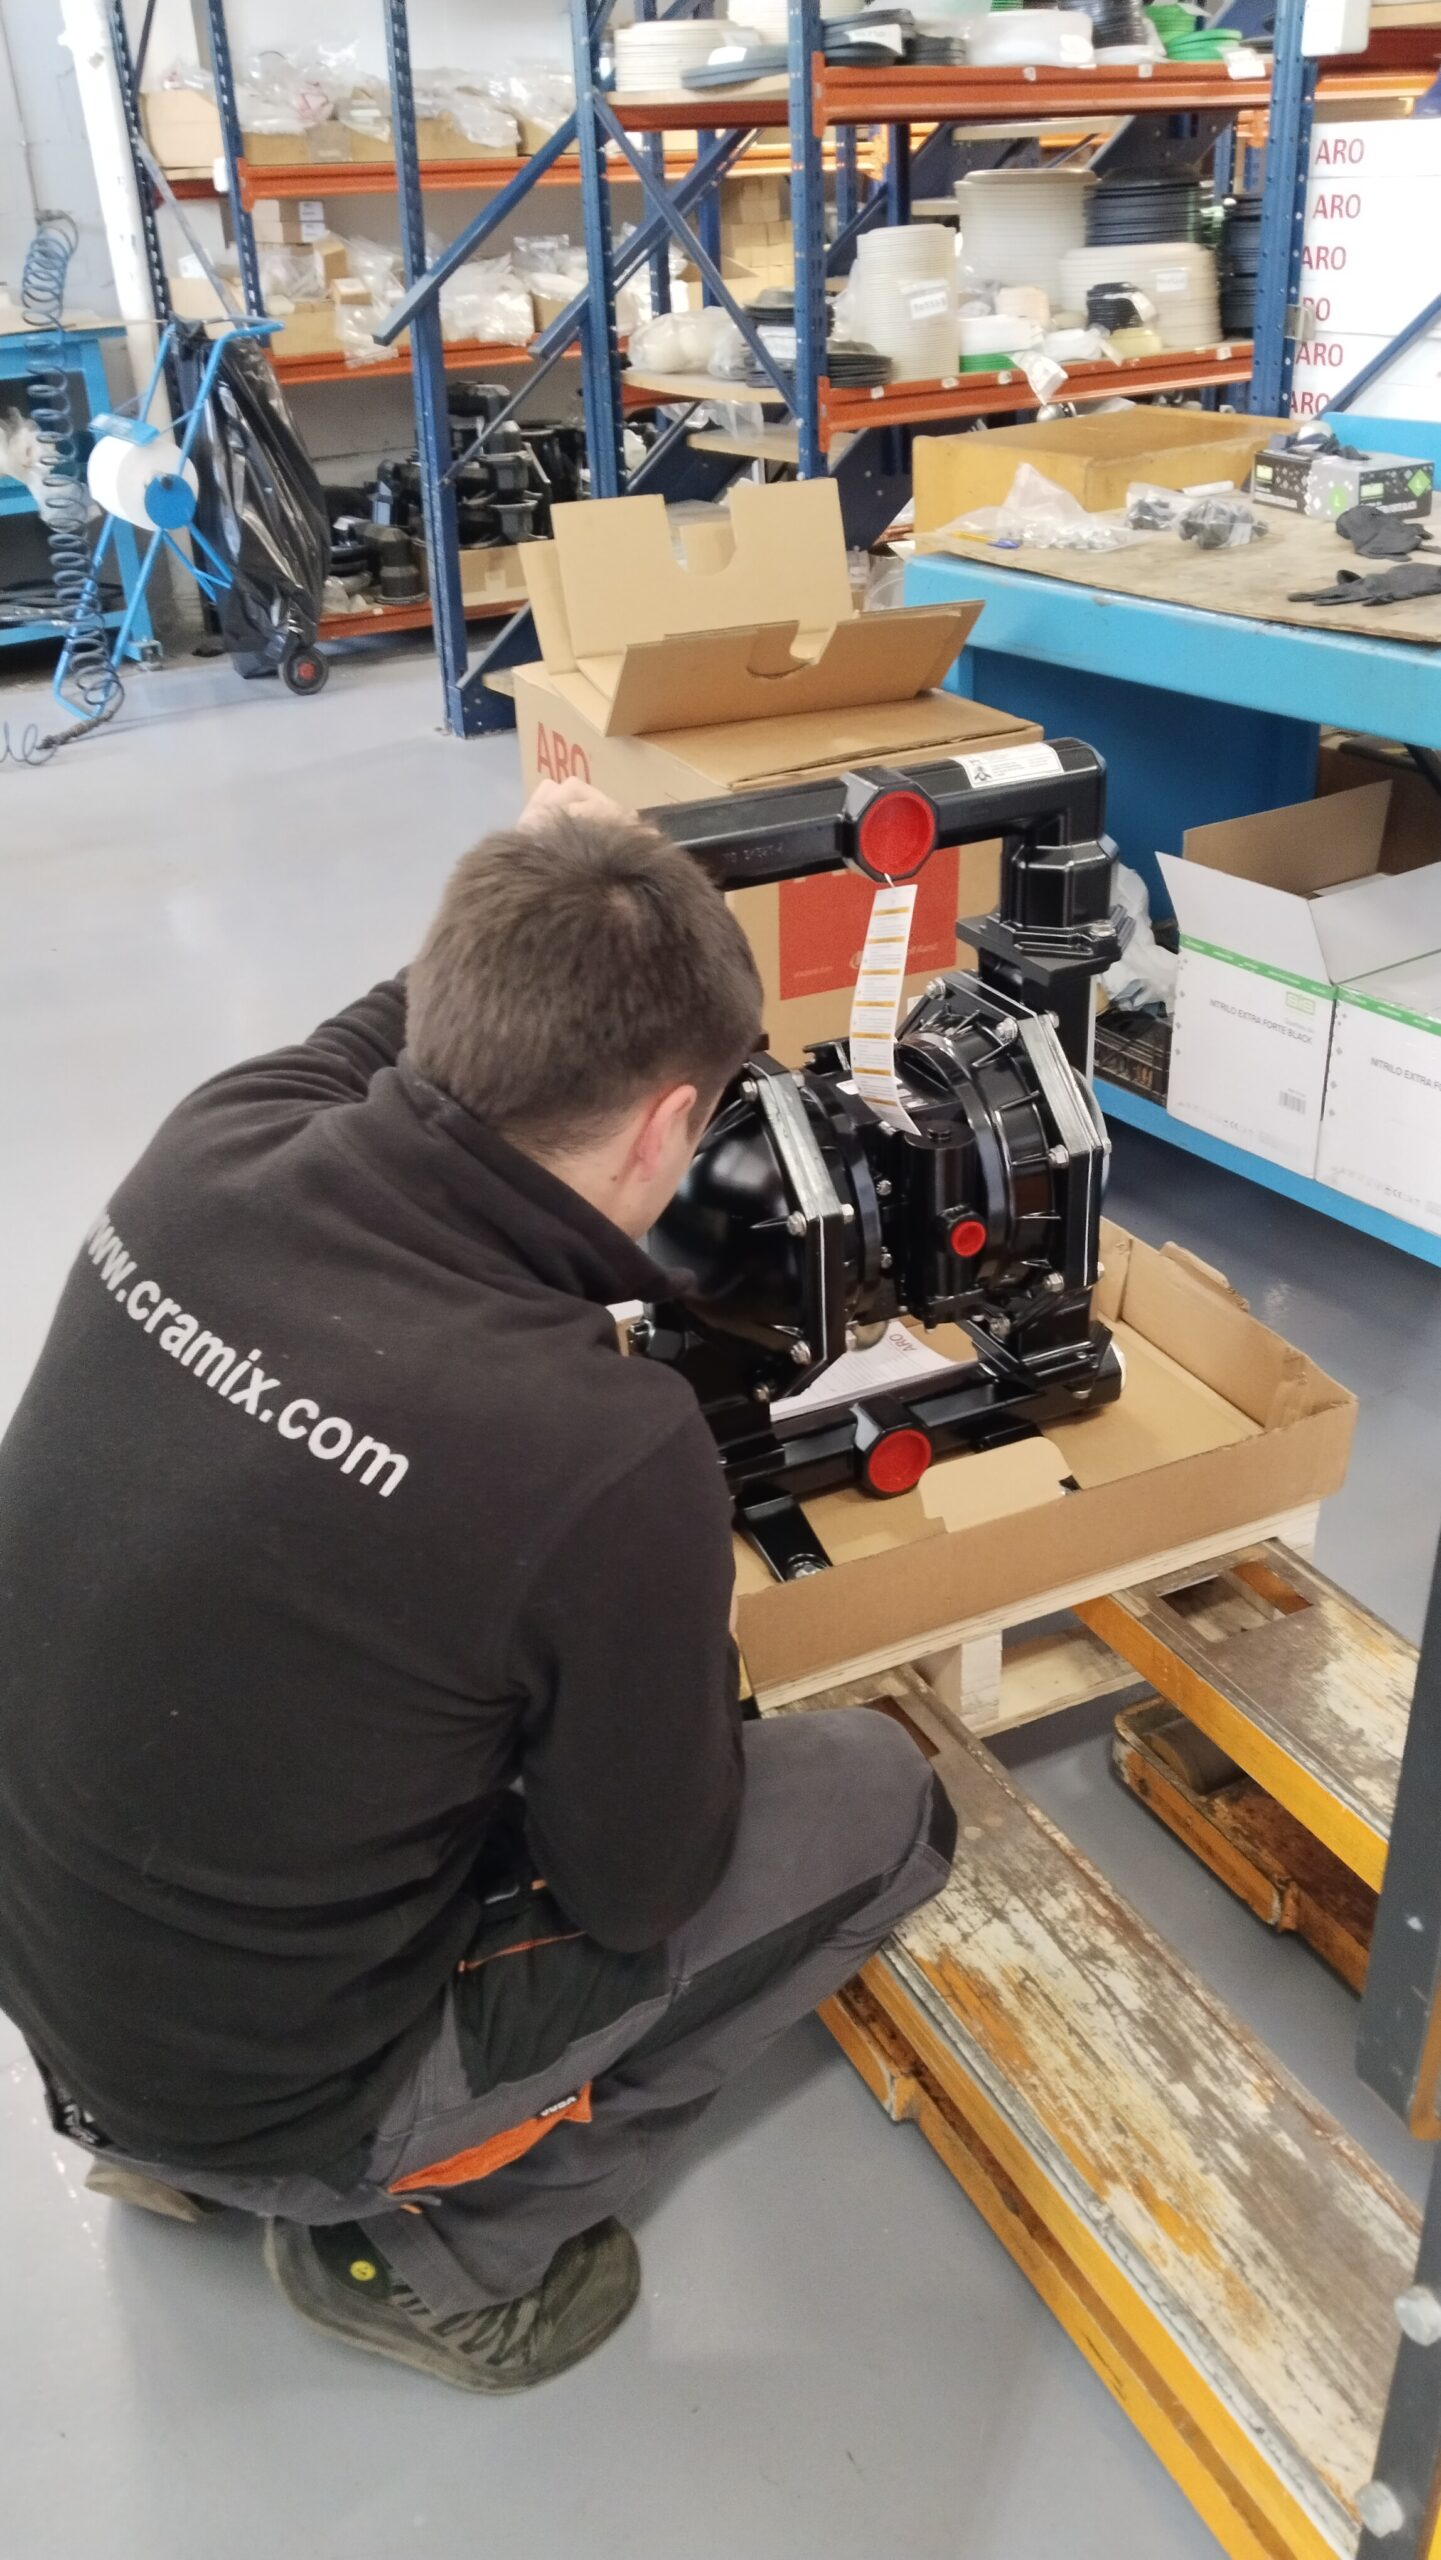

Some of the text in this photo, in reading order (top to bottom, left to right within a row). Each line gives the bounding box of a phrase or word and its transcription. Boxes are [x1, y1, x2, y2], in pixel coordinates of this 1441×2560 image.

[1314, 138, 1365, 165] ARO
[1312, 194, 1361, 219] ARO
[1301, 246, 1347, 270] ARO
[1295, 341, 1344, 367] ARO
[537, 721, 592, 785] ARO
[1238, 1009, 1261, 1024] EXTRA
[1262, 1019, 1287, 1035] FORTE
[1287, 1028, 1313, 1045] BLACK
[1370, 1057, 1402, 1076] NITRILO
[1404, 1069, 1432, 1087] EXTRA
[889, 1334, 917, 1351] ARO
